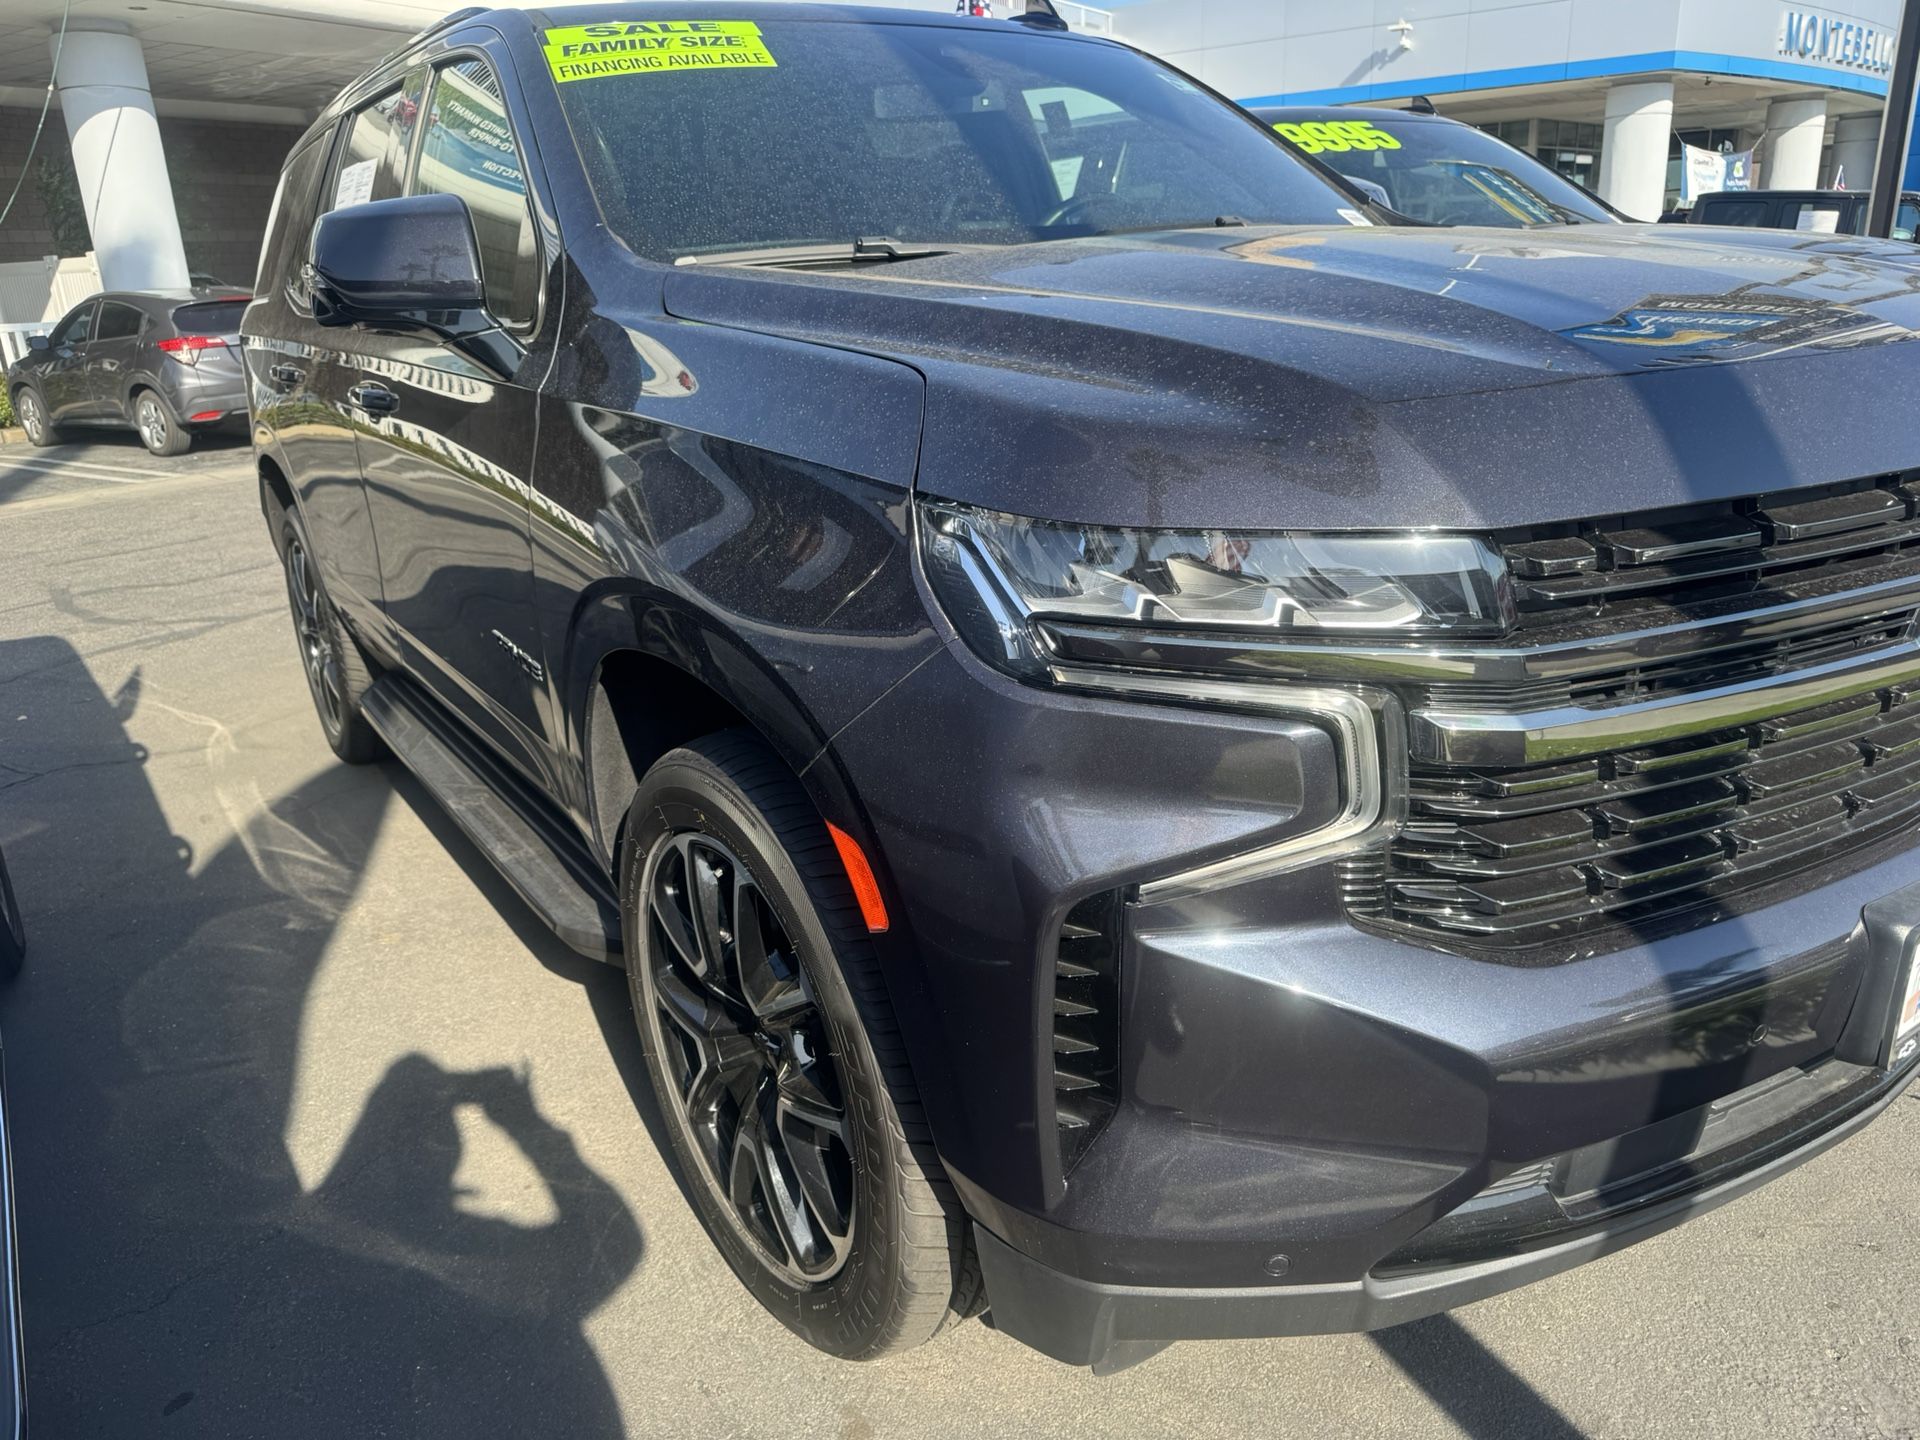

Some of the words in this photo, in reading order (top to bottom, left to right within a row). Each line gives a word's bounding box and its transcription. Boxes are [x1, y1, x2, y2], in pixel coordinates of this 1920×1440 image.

[584, 23, 721, 37] SALE
[562, 36, 671, 57] FAMILY
[680, 35, 743, 48] SIZE
[558, 56, 662, 78] FINANCING
[668, 52, 769, 66] AVAILABLE
[1272, 121, 1402, 154] 9995
